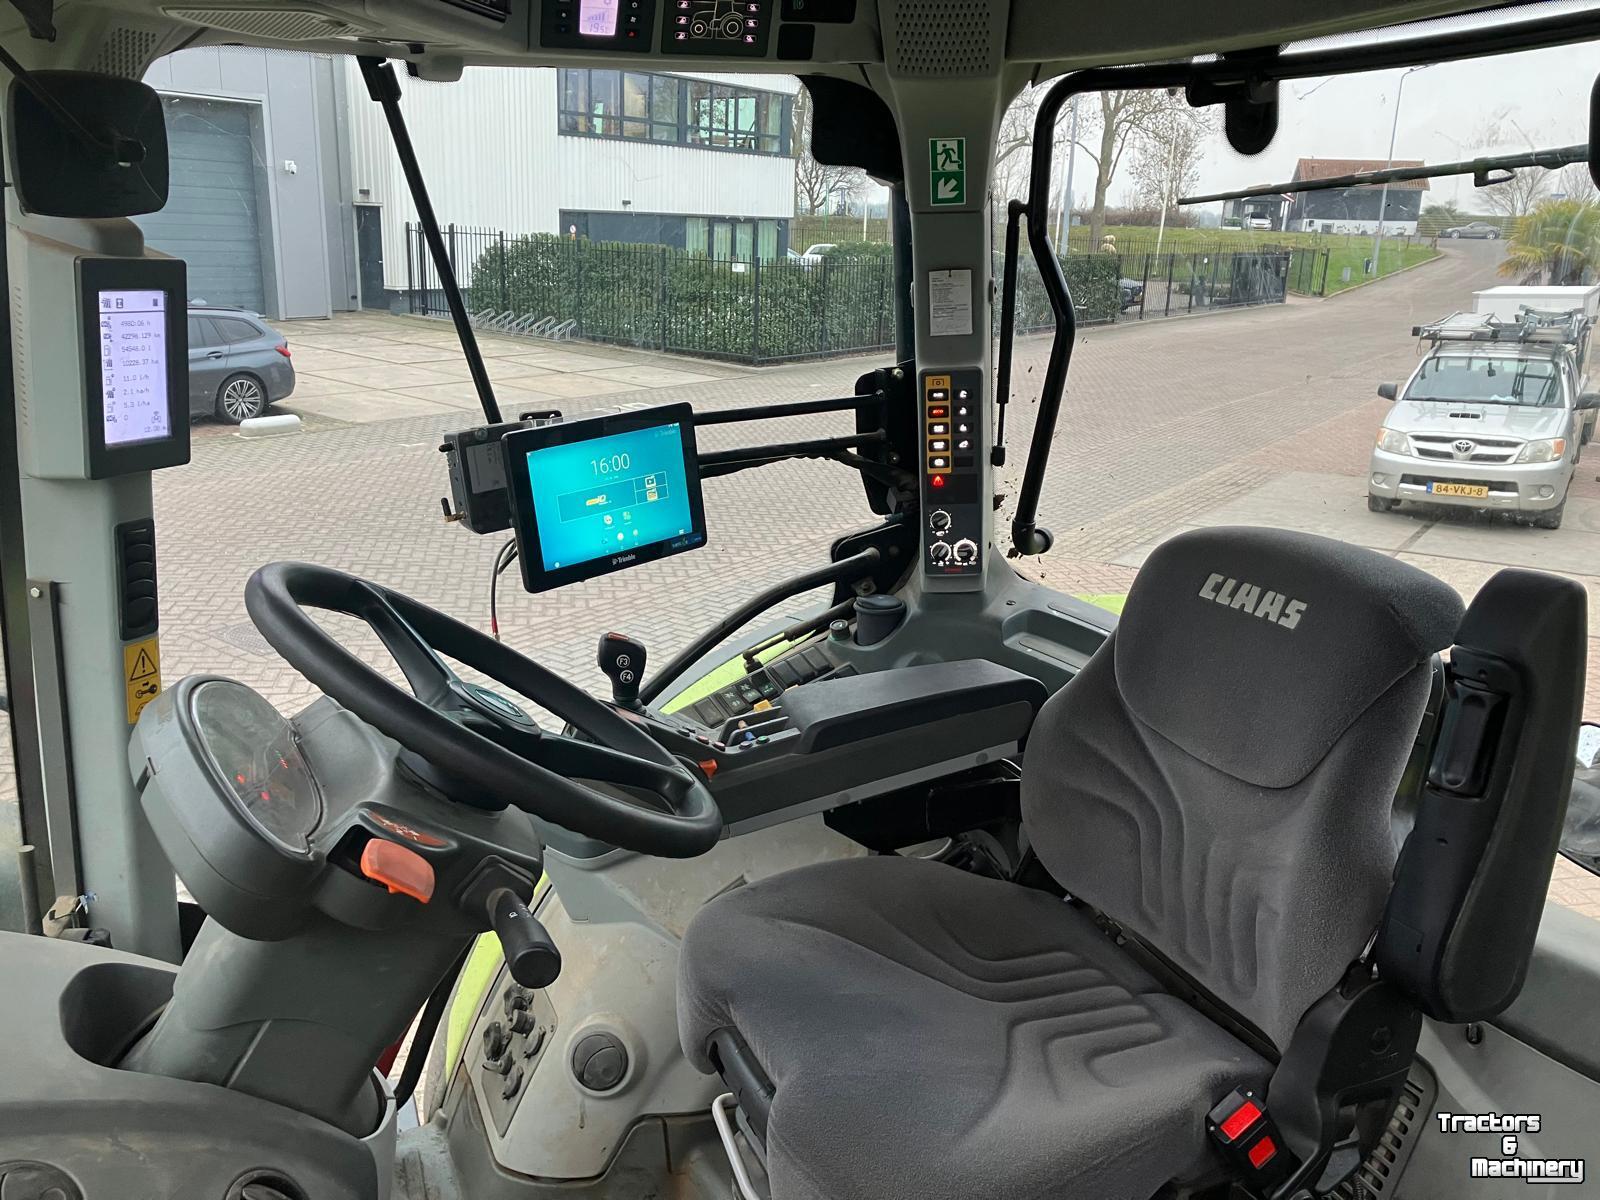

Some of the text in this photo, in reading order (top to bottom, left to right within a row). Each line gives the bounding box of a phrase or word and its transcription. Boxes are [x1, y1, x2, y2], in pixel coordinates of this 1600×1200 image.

[590, 453, 630, 476] 16:00
[1436, 484, 1483, 496] 84-VKJ-8
[1198, 572, 1309, 631] CLAAS
[619, 657, 628, 667] F3
[622, 672, 632, 681] F4
